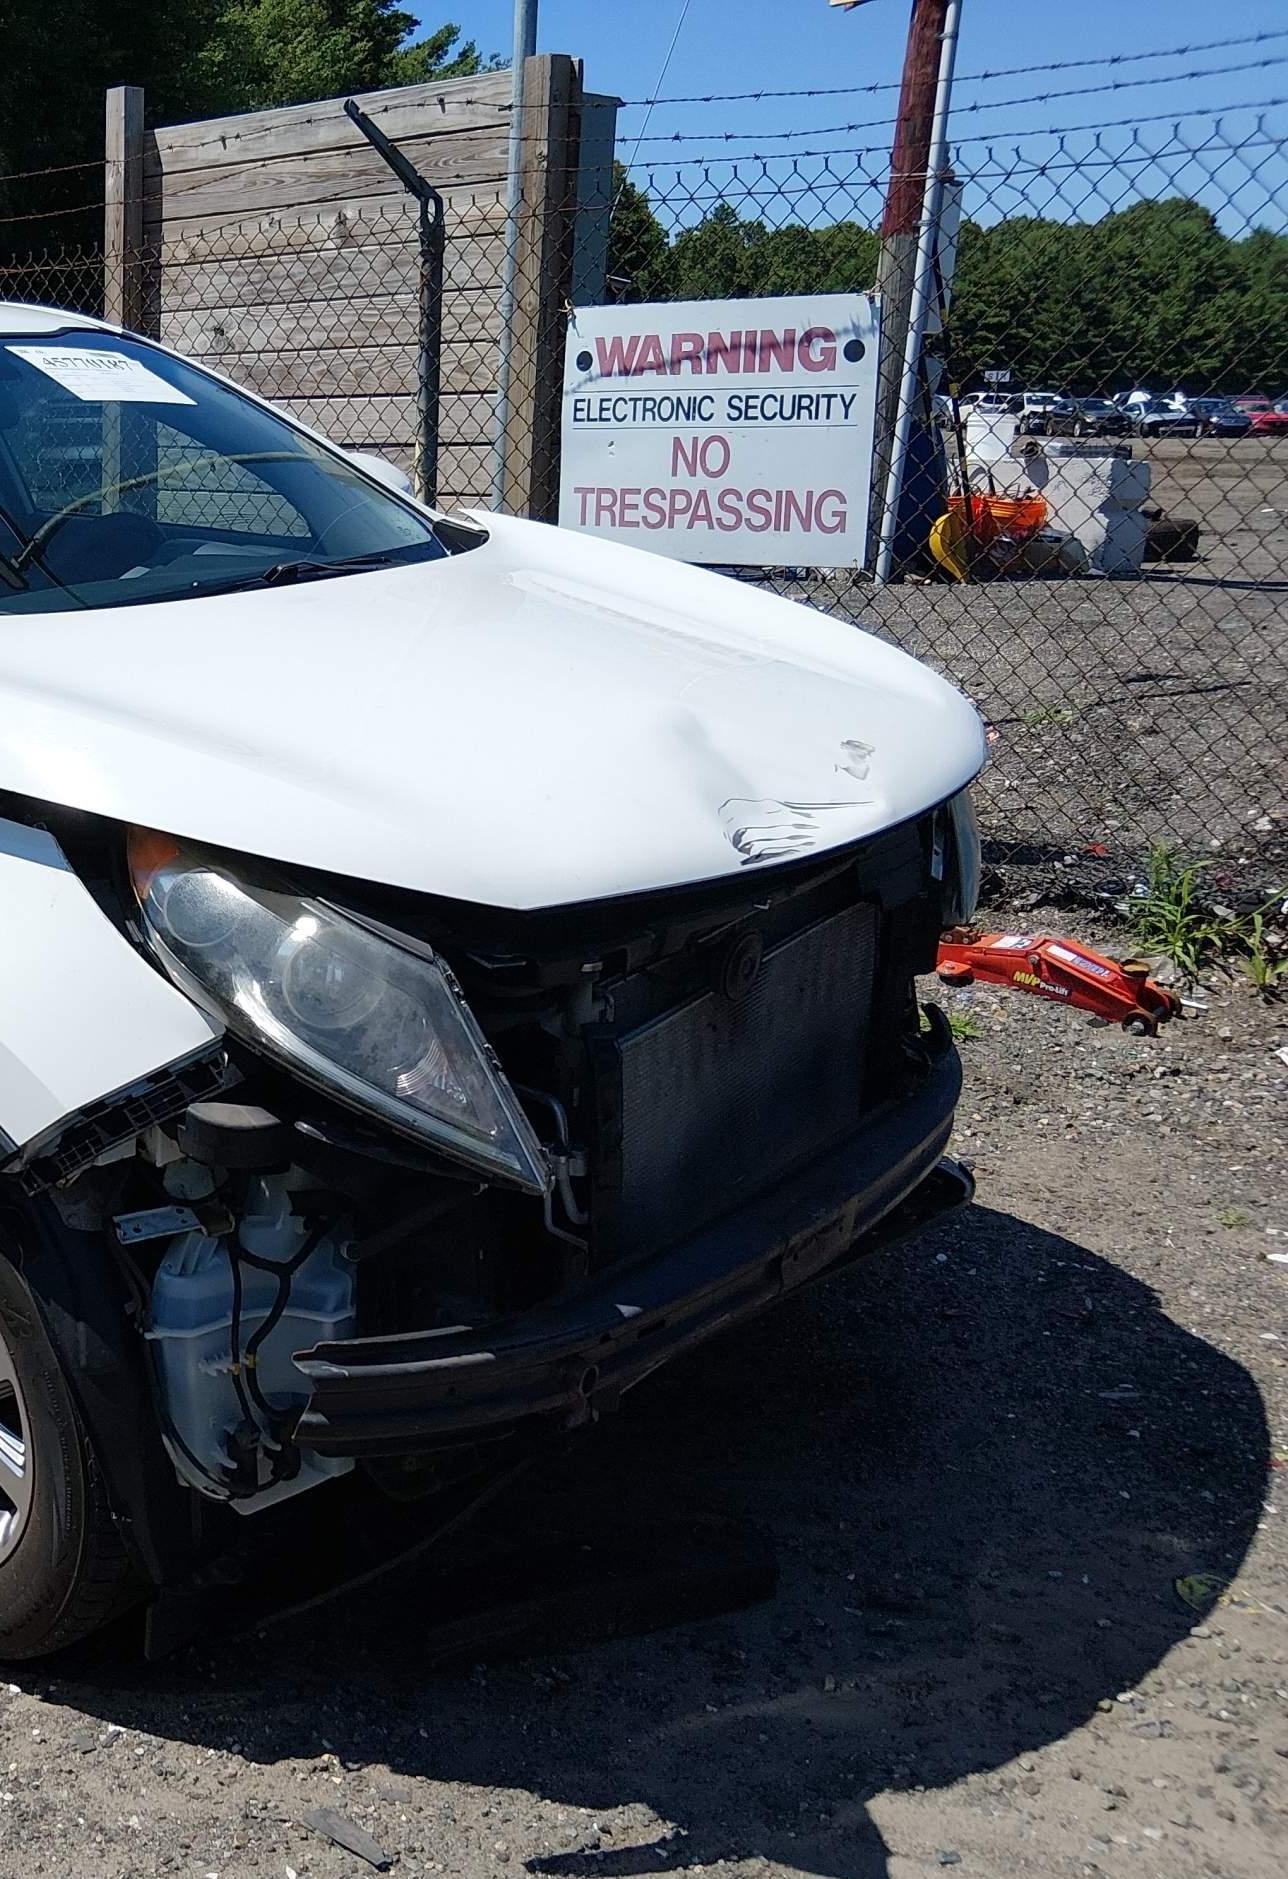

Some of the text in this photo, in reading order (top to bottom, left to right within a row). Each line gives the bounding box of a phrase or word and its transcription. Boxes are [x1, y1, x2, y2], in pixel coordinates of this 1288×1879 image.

[42, 357, 133, 371] 45770187
[595, 327, 837, 377] WARNING
[573, 393, 857, 423] ELECTRONIC SECURITY
[671, 434, 731, 478] NO
[573, 486, 847, 535] TRESPASSING
[1013, 970, 1041, 987] MVP
